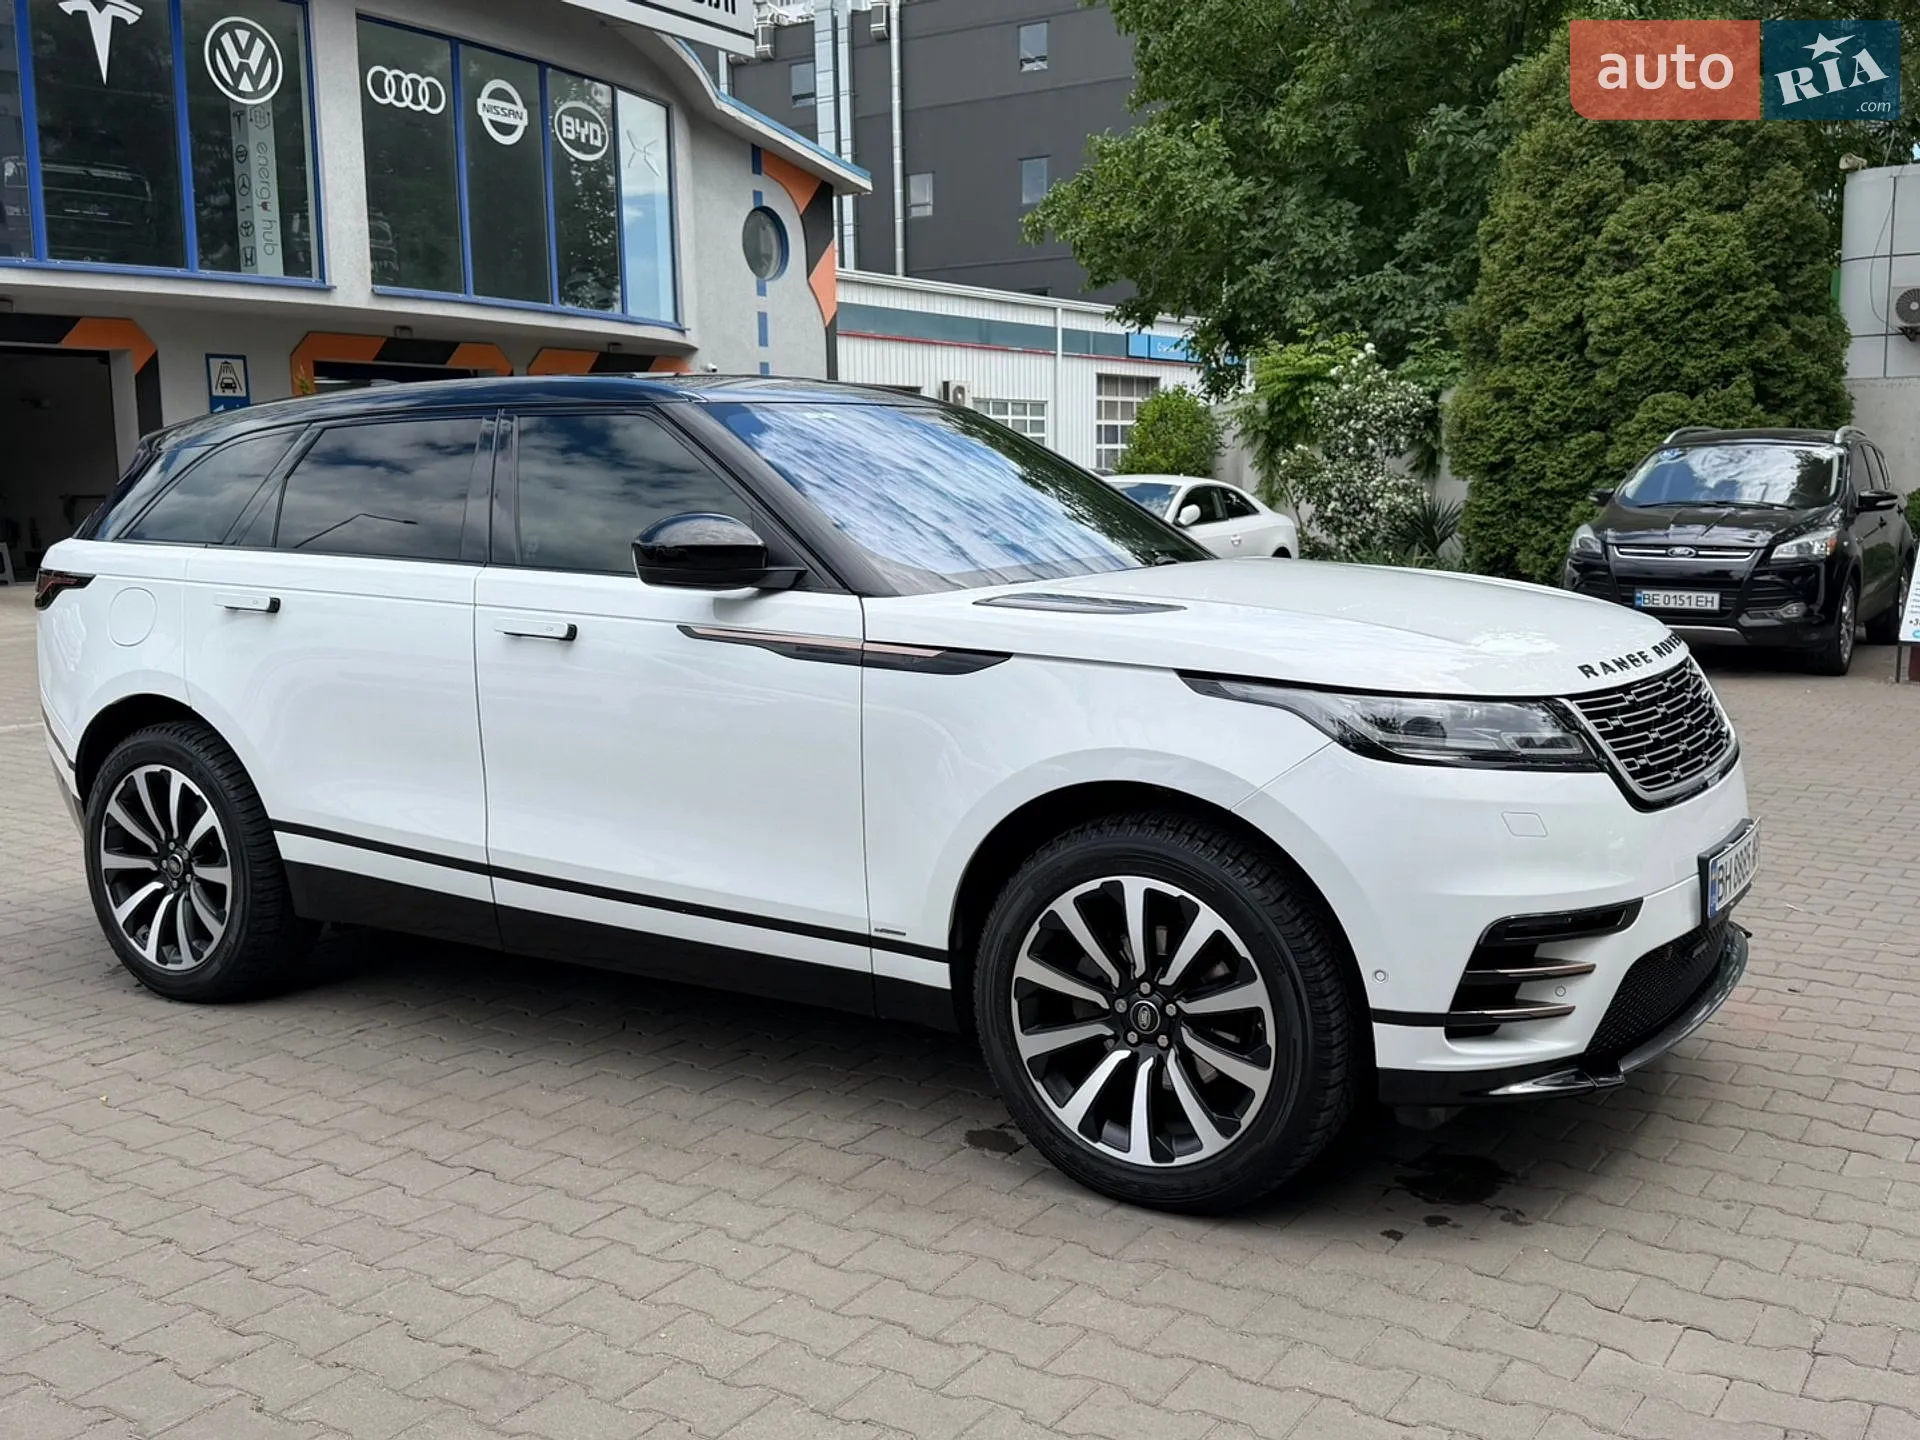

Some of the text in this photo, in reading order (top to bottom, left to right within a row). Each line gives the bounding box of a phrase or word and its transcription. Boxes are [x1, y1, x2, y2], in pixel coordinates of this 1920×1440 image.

[481, 102, 524, 121] NISSAN
[561, 114, 603, 147] BYD
[254, 141, 279, 256] energy hub
[1642, 593, 1715, 608] BE 0151 EH
[1577, 650, 1654, 679] RANGE
